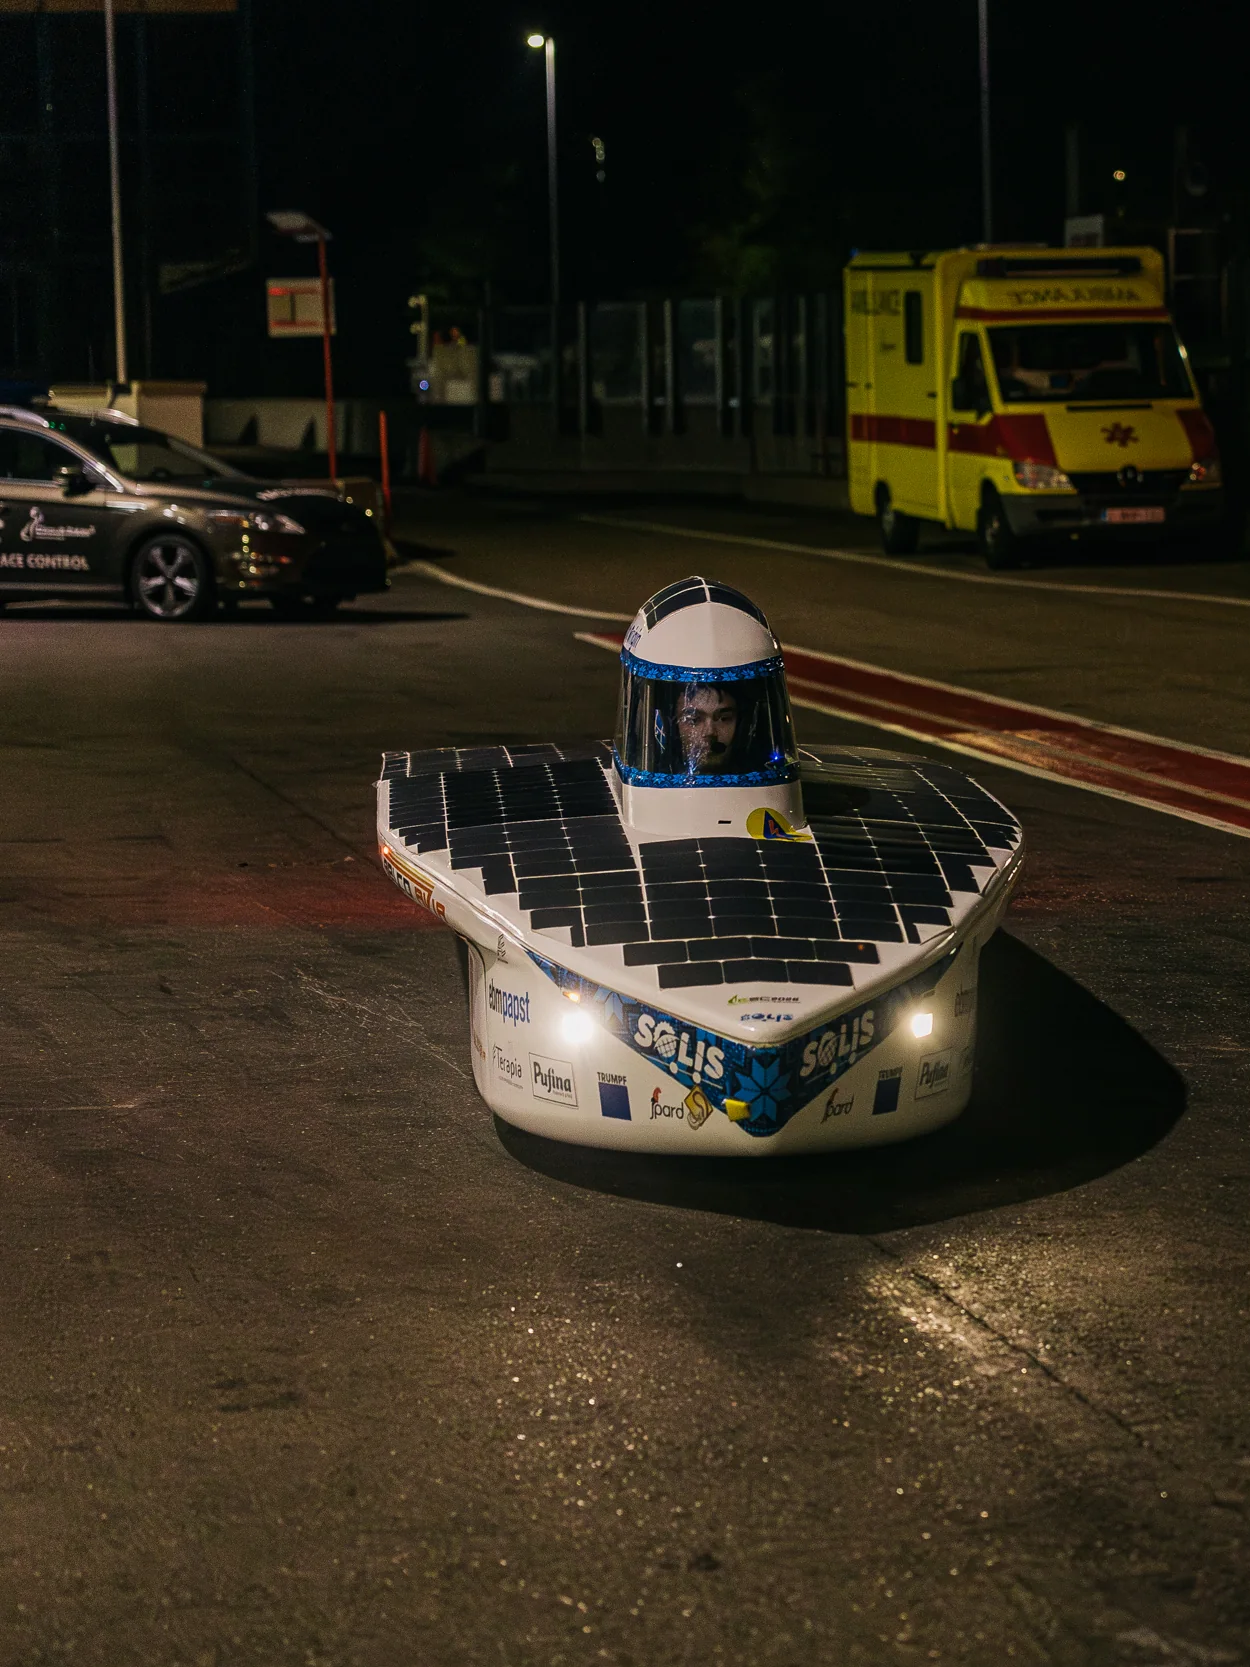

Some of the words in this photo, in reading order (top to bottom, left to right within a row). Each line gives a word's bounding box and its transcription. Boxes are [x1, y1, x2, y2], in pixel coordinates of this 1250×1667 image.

[26, 554, 90, 571] CONTROL
[633, 1013, 725, 1079] SOLIS
[799, 1009, 875, 1077] SOLIS
[495, 1045, 523, 1079] Terapia
[533, 1061, 572, 1093] Pufina
[597, 1071, 628, 1085] TRUMPF
